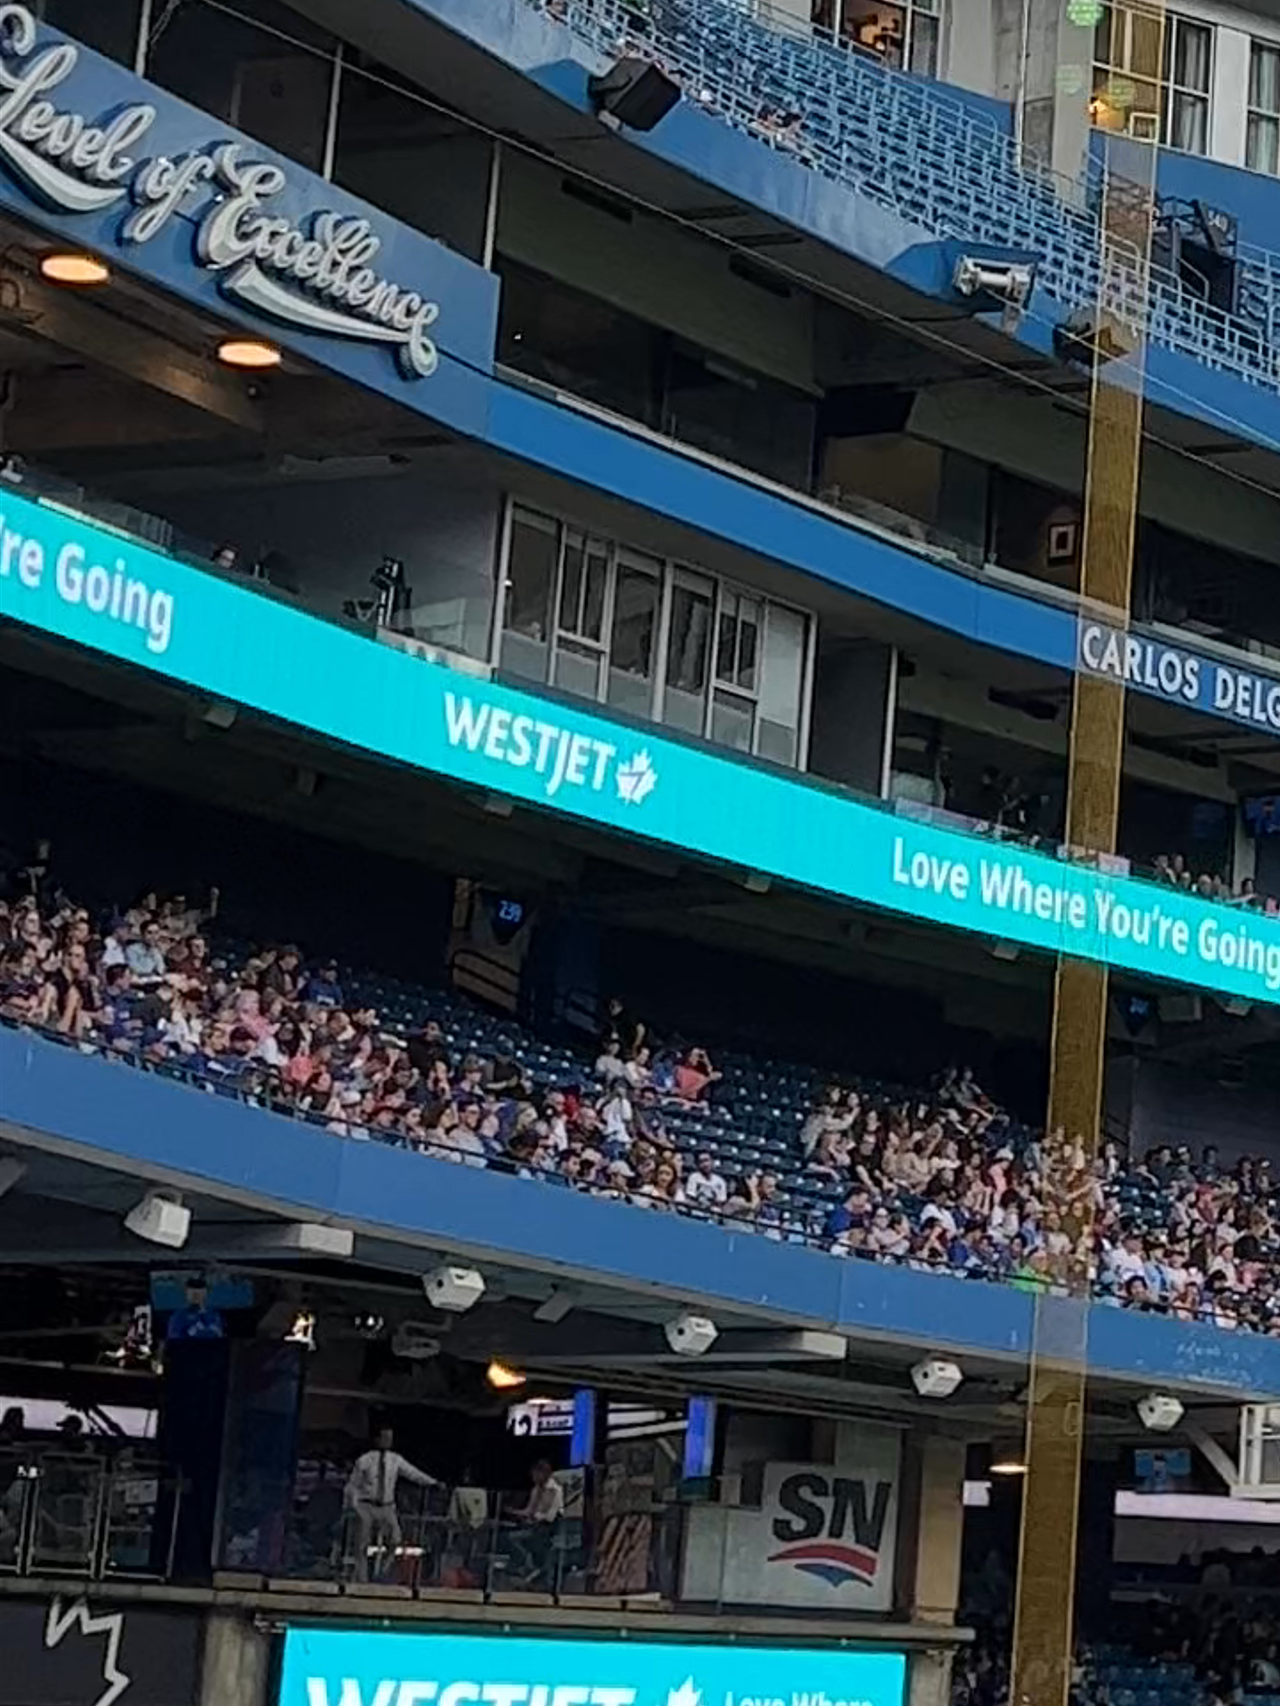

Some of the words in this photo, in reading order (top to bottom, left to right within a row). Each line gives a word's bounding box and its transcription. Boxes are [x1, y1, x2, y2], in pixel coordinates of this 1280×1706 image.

[0, 5, 156, 212] Level
[122, 153, 215, 244] of
[200, 142, 440, 377] Excellence
[56, 543, 174, 653] Going
[1082, 626, 1199, 700] CARLOS
[444, 692, 616, 796] WESTJET
[893, 838, 970, 899] Love
[979, 858, 1086, 927] Where
[1095, 888, 1190, 955] You're
[773, 1473, 892, 1553] SN
